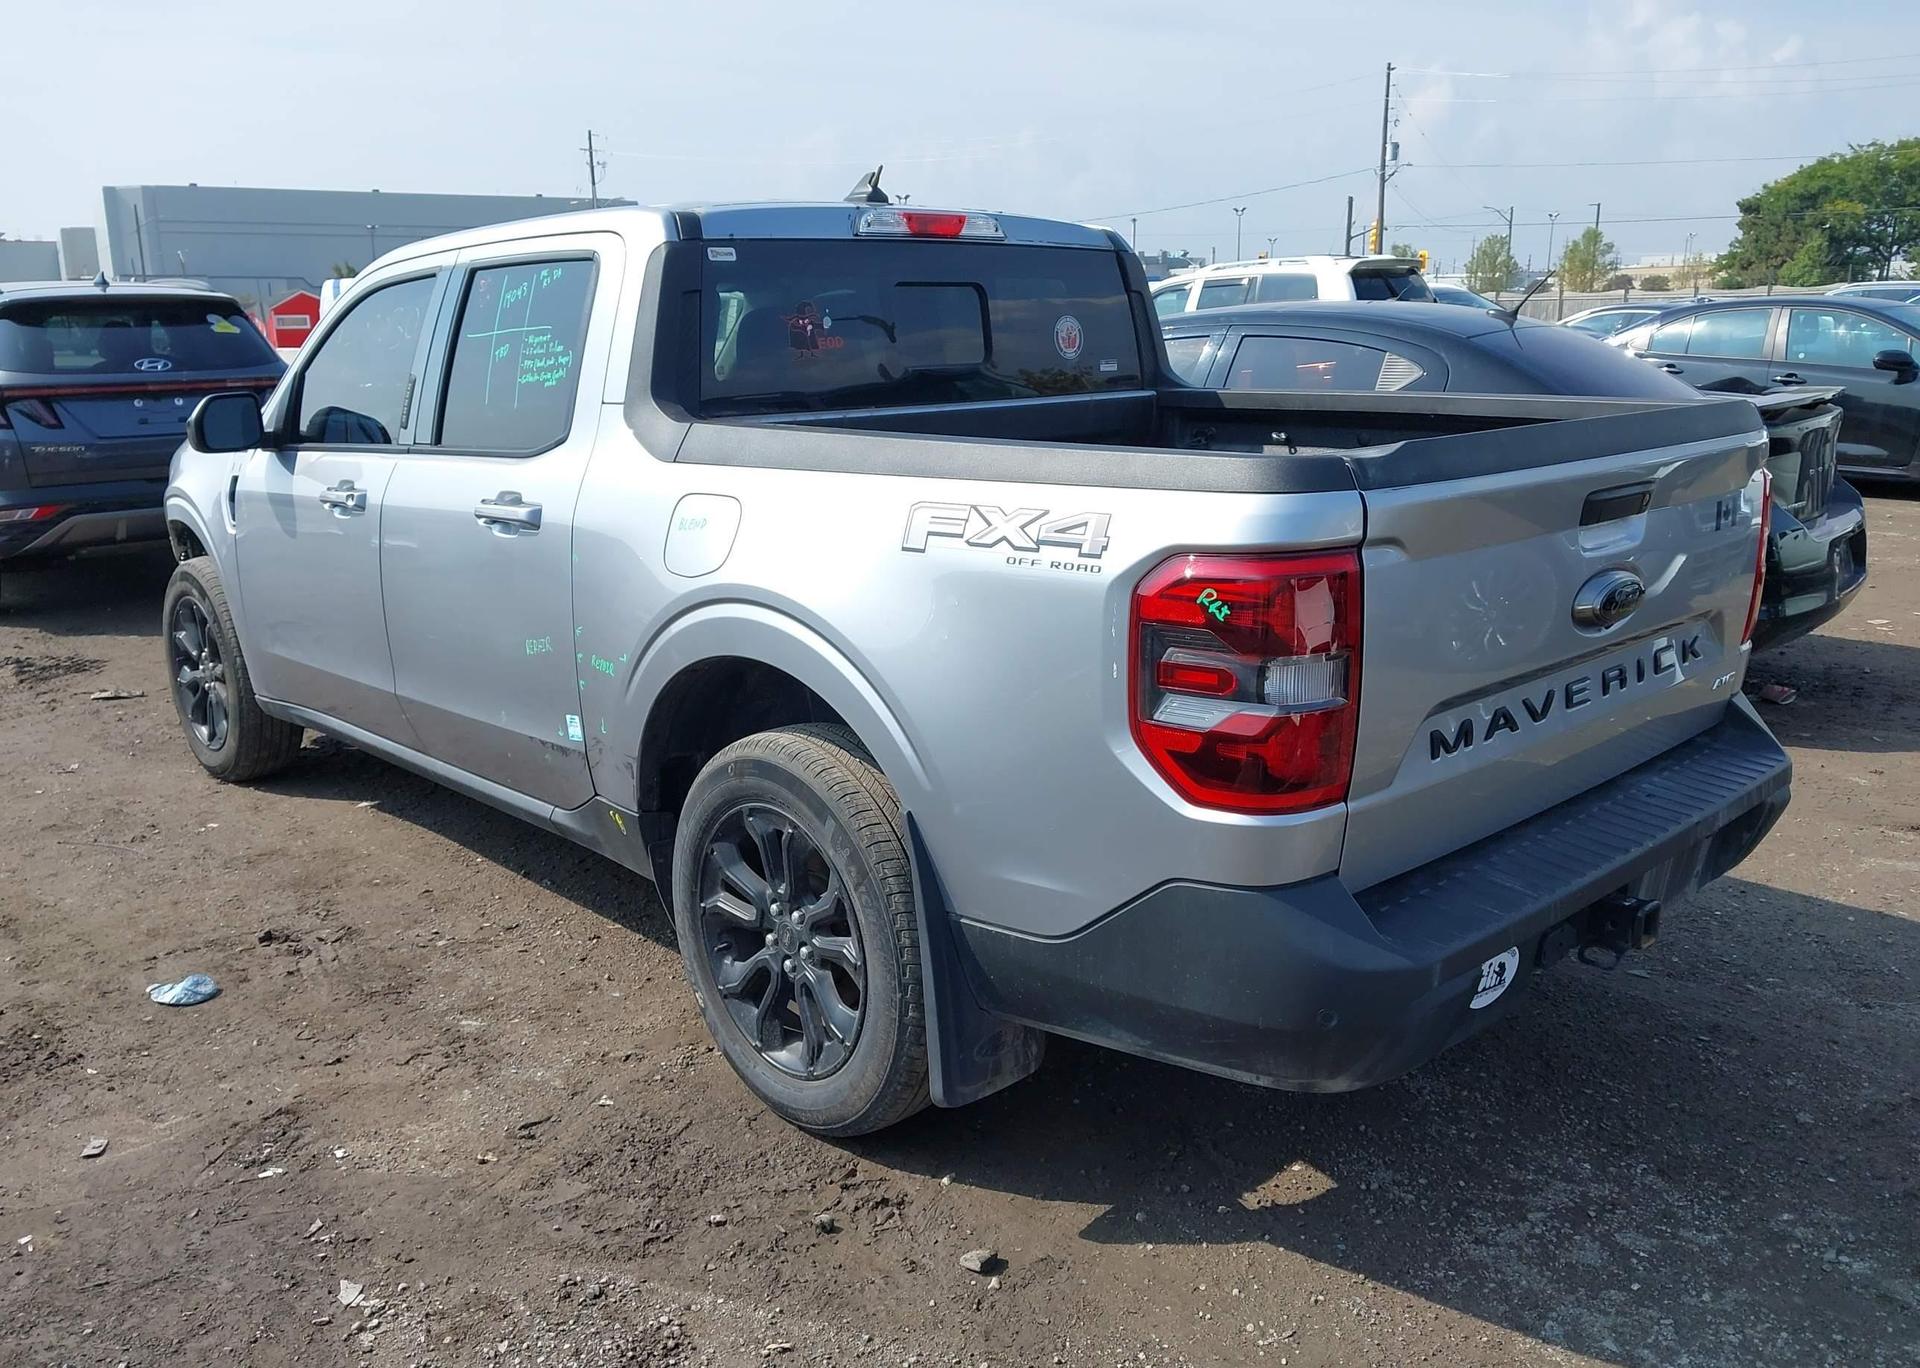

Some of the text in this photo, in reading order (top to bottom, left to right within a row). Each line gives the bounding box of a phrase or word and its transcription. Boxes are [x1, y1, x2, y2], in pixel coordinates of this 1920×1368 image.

[902, 501, 1112, 559] FX4
[1006, 556, 1102, 574] OFF ROAD
[1430, 635, 1703, 762] MAVERICK
